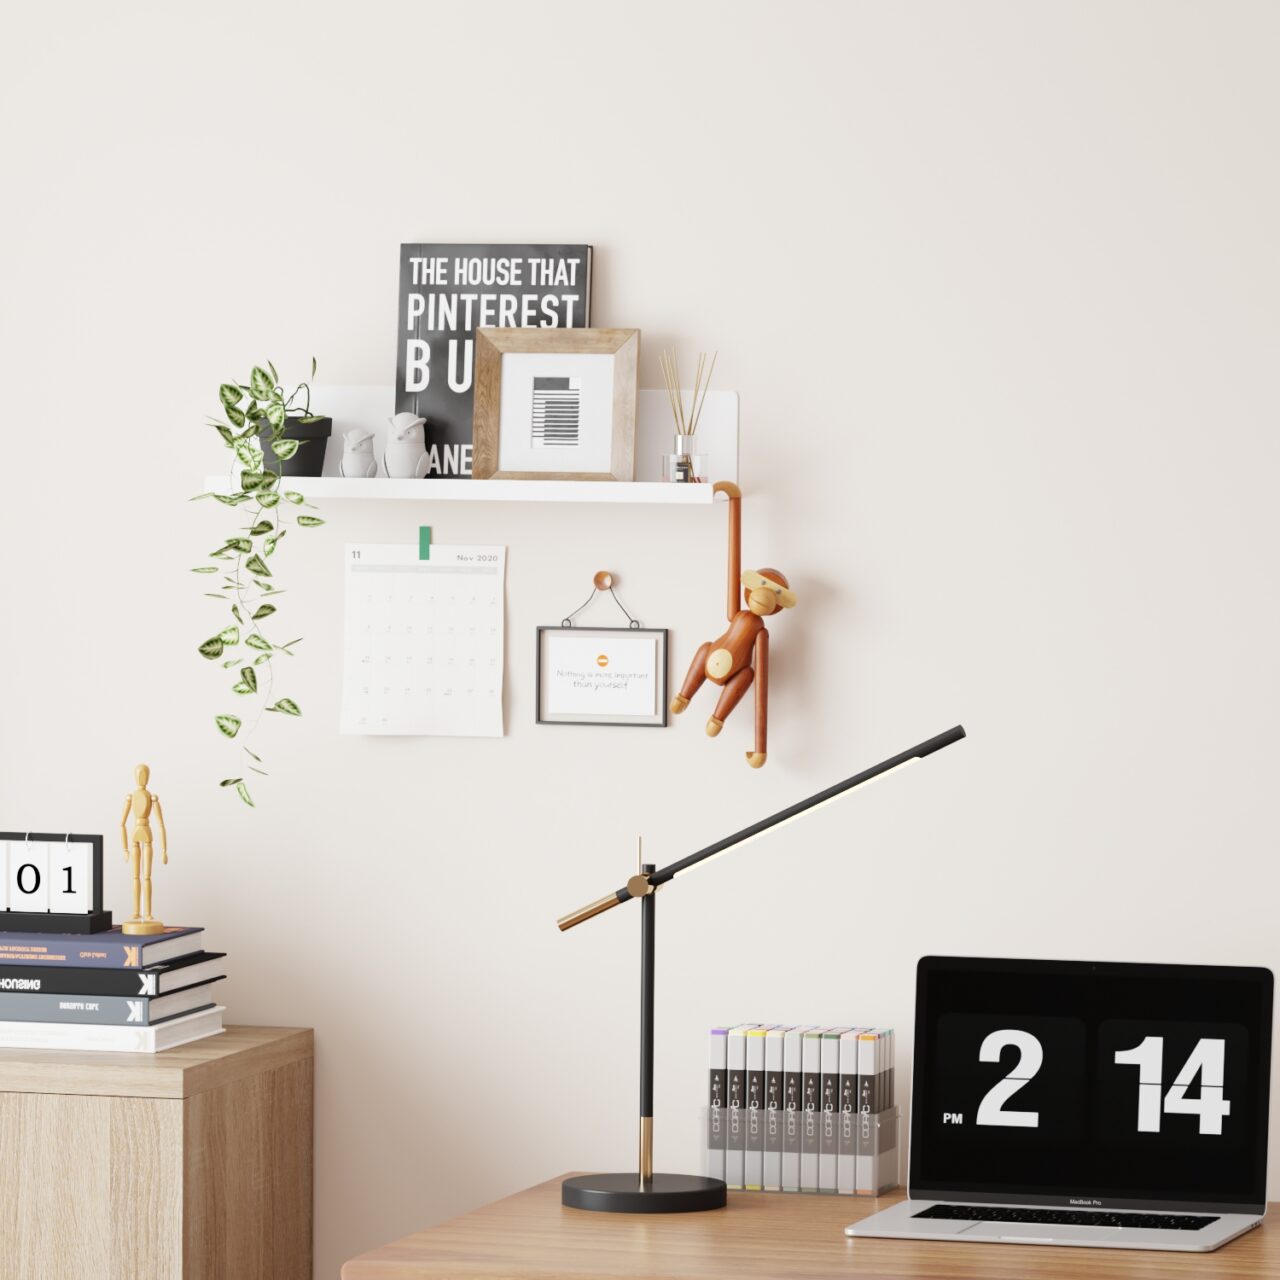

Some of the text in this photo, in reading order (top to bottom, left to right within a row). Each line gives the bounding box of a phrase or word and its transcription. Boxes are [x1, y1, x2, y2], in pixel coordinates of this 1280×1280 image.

[410, 258, 580, 286] THE HOUSE THAT
[407, 293, 579, 331] PINTEREST
[429, 443, 473, 475] ANE
[352, 550, 361, 558] 11
[976, 1029, 1231, 1135] 2 14
[943, 1113, 963, 1124] PM
